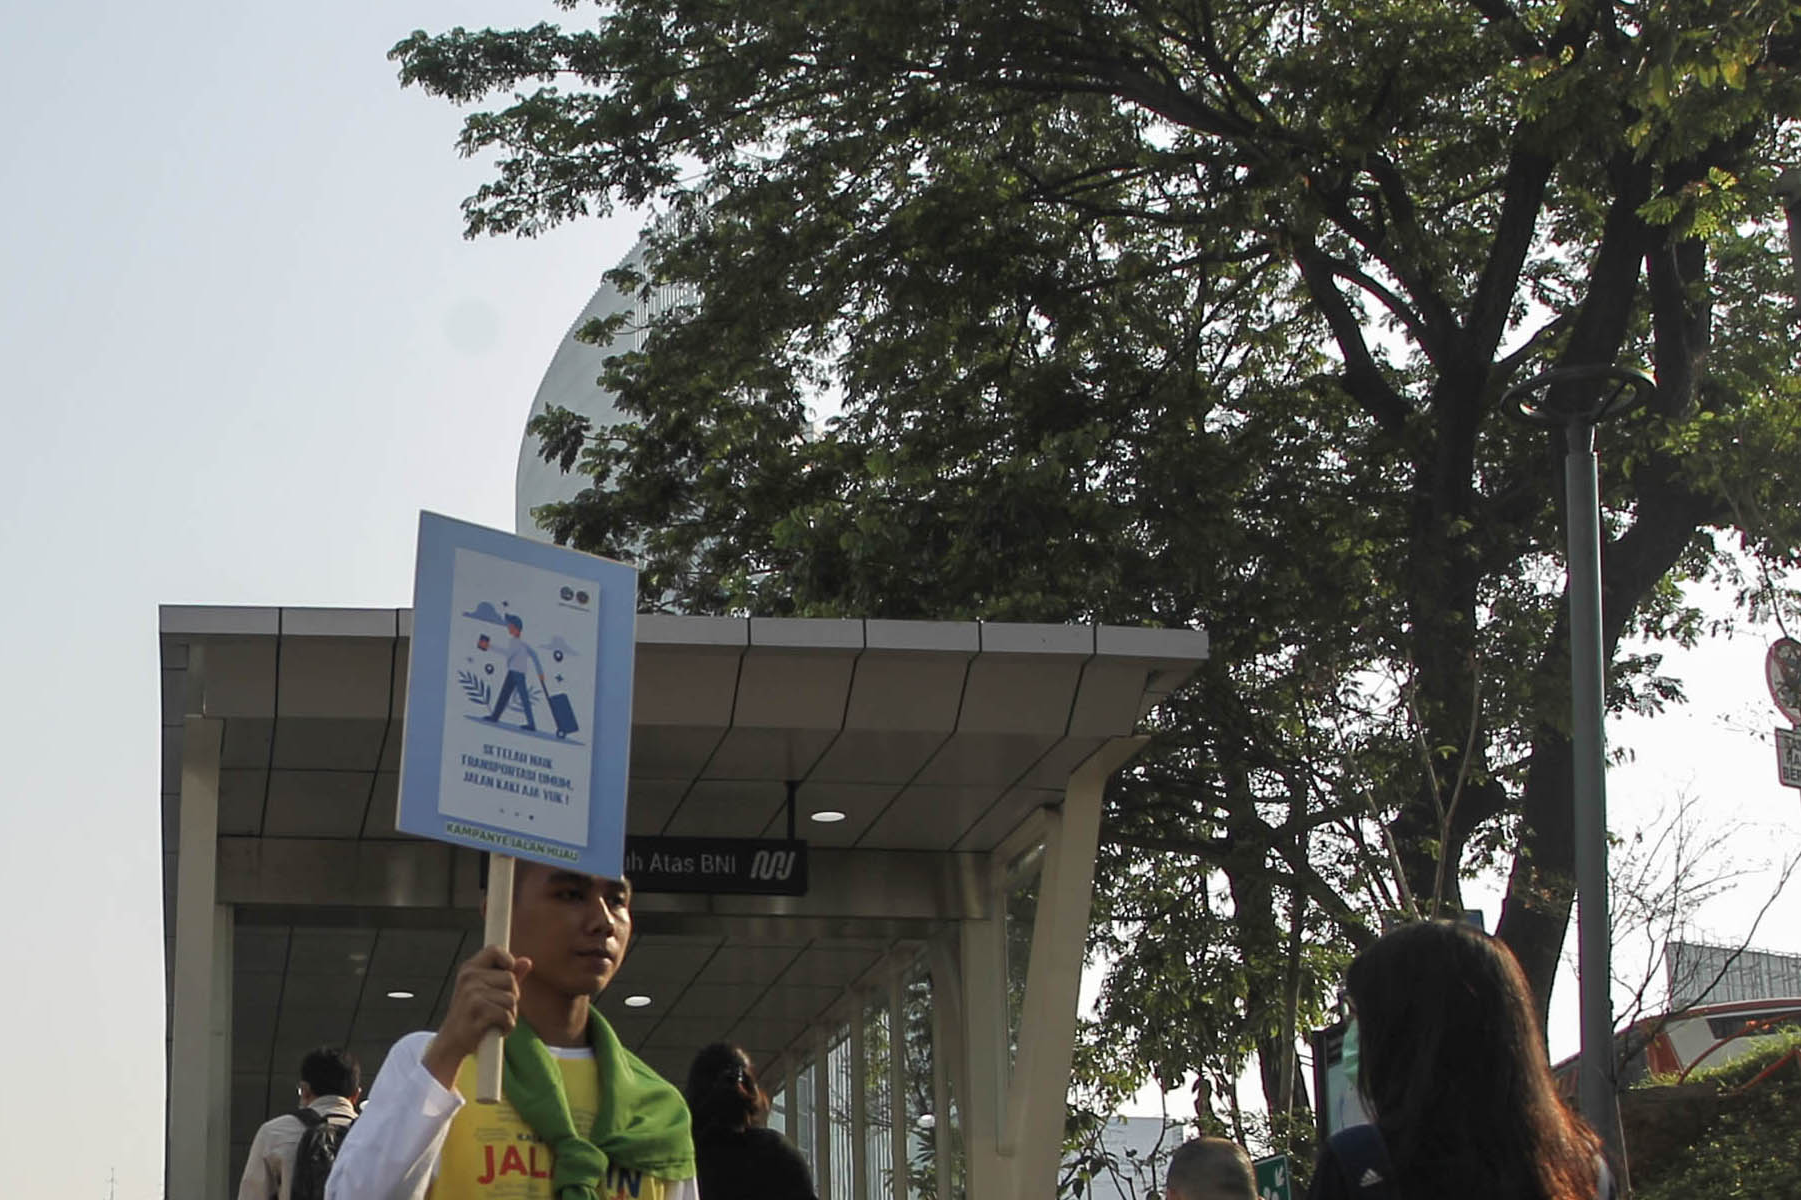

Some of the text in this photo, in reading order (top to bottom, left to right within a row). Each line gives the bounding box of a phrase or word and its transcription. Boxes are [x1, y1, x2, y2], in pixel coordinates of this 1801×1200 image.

[462, 754, 536, 783] TRANSPORTASI
[463, 771, 494, 788] JALAN
[496, 778, 519, 793] KAKI
[522, 784, 540, 799] AJA
[446, 822, 509, 845] KAMPANYE
[510, 834, 544, 855] JALAN
[649, 852, 694, 873] Atas
[701, 854, 736, 874] BNI
